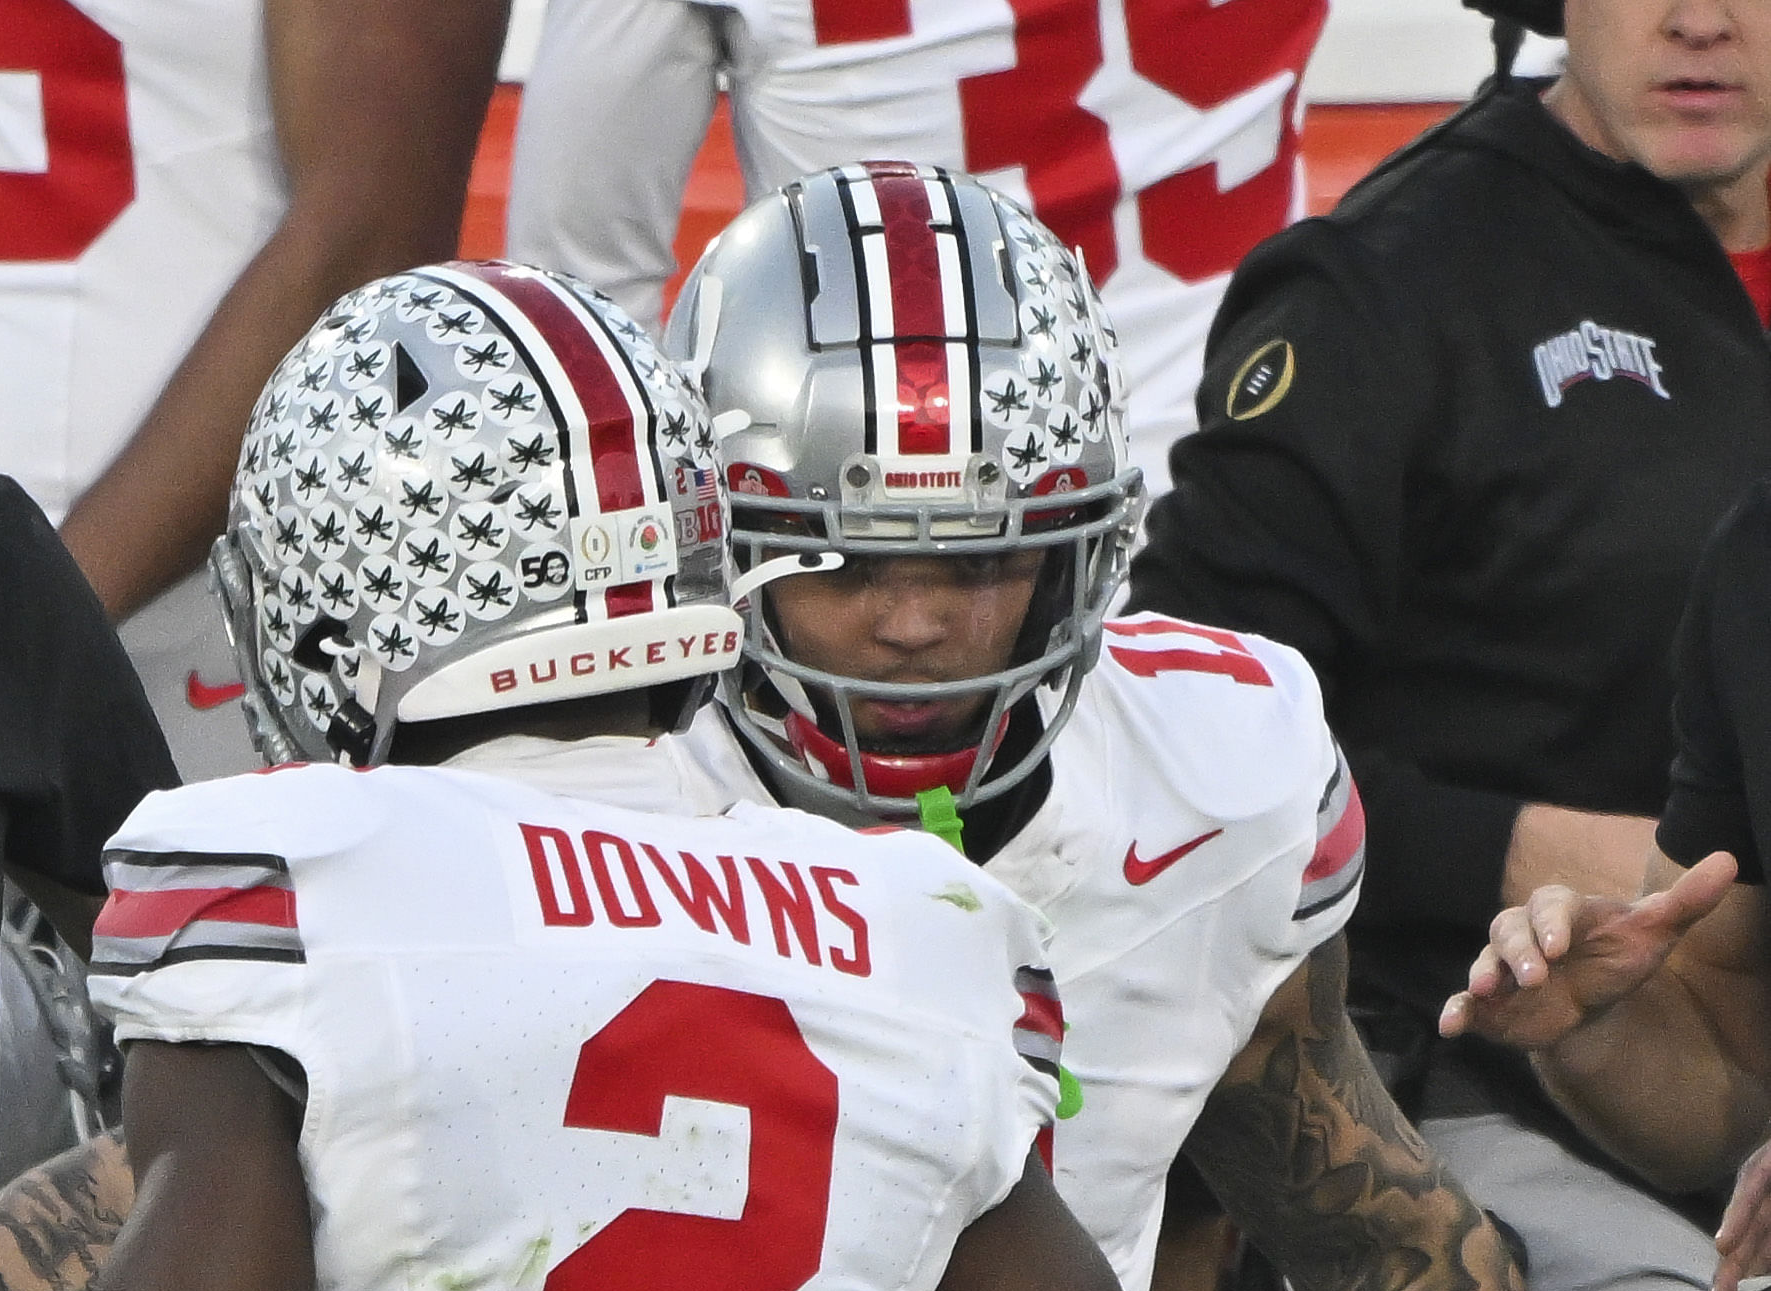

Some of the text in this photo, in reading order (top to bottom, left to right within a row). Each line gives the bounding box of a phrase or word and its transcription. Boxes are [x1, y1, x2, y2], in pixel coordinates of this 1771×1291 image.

[584, 566, 613, 582] CFP
[489, 631, 739, 694] BUCKEYES
[518, 822, 872, 979] DOWNS
